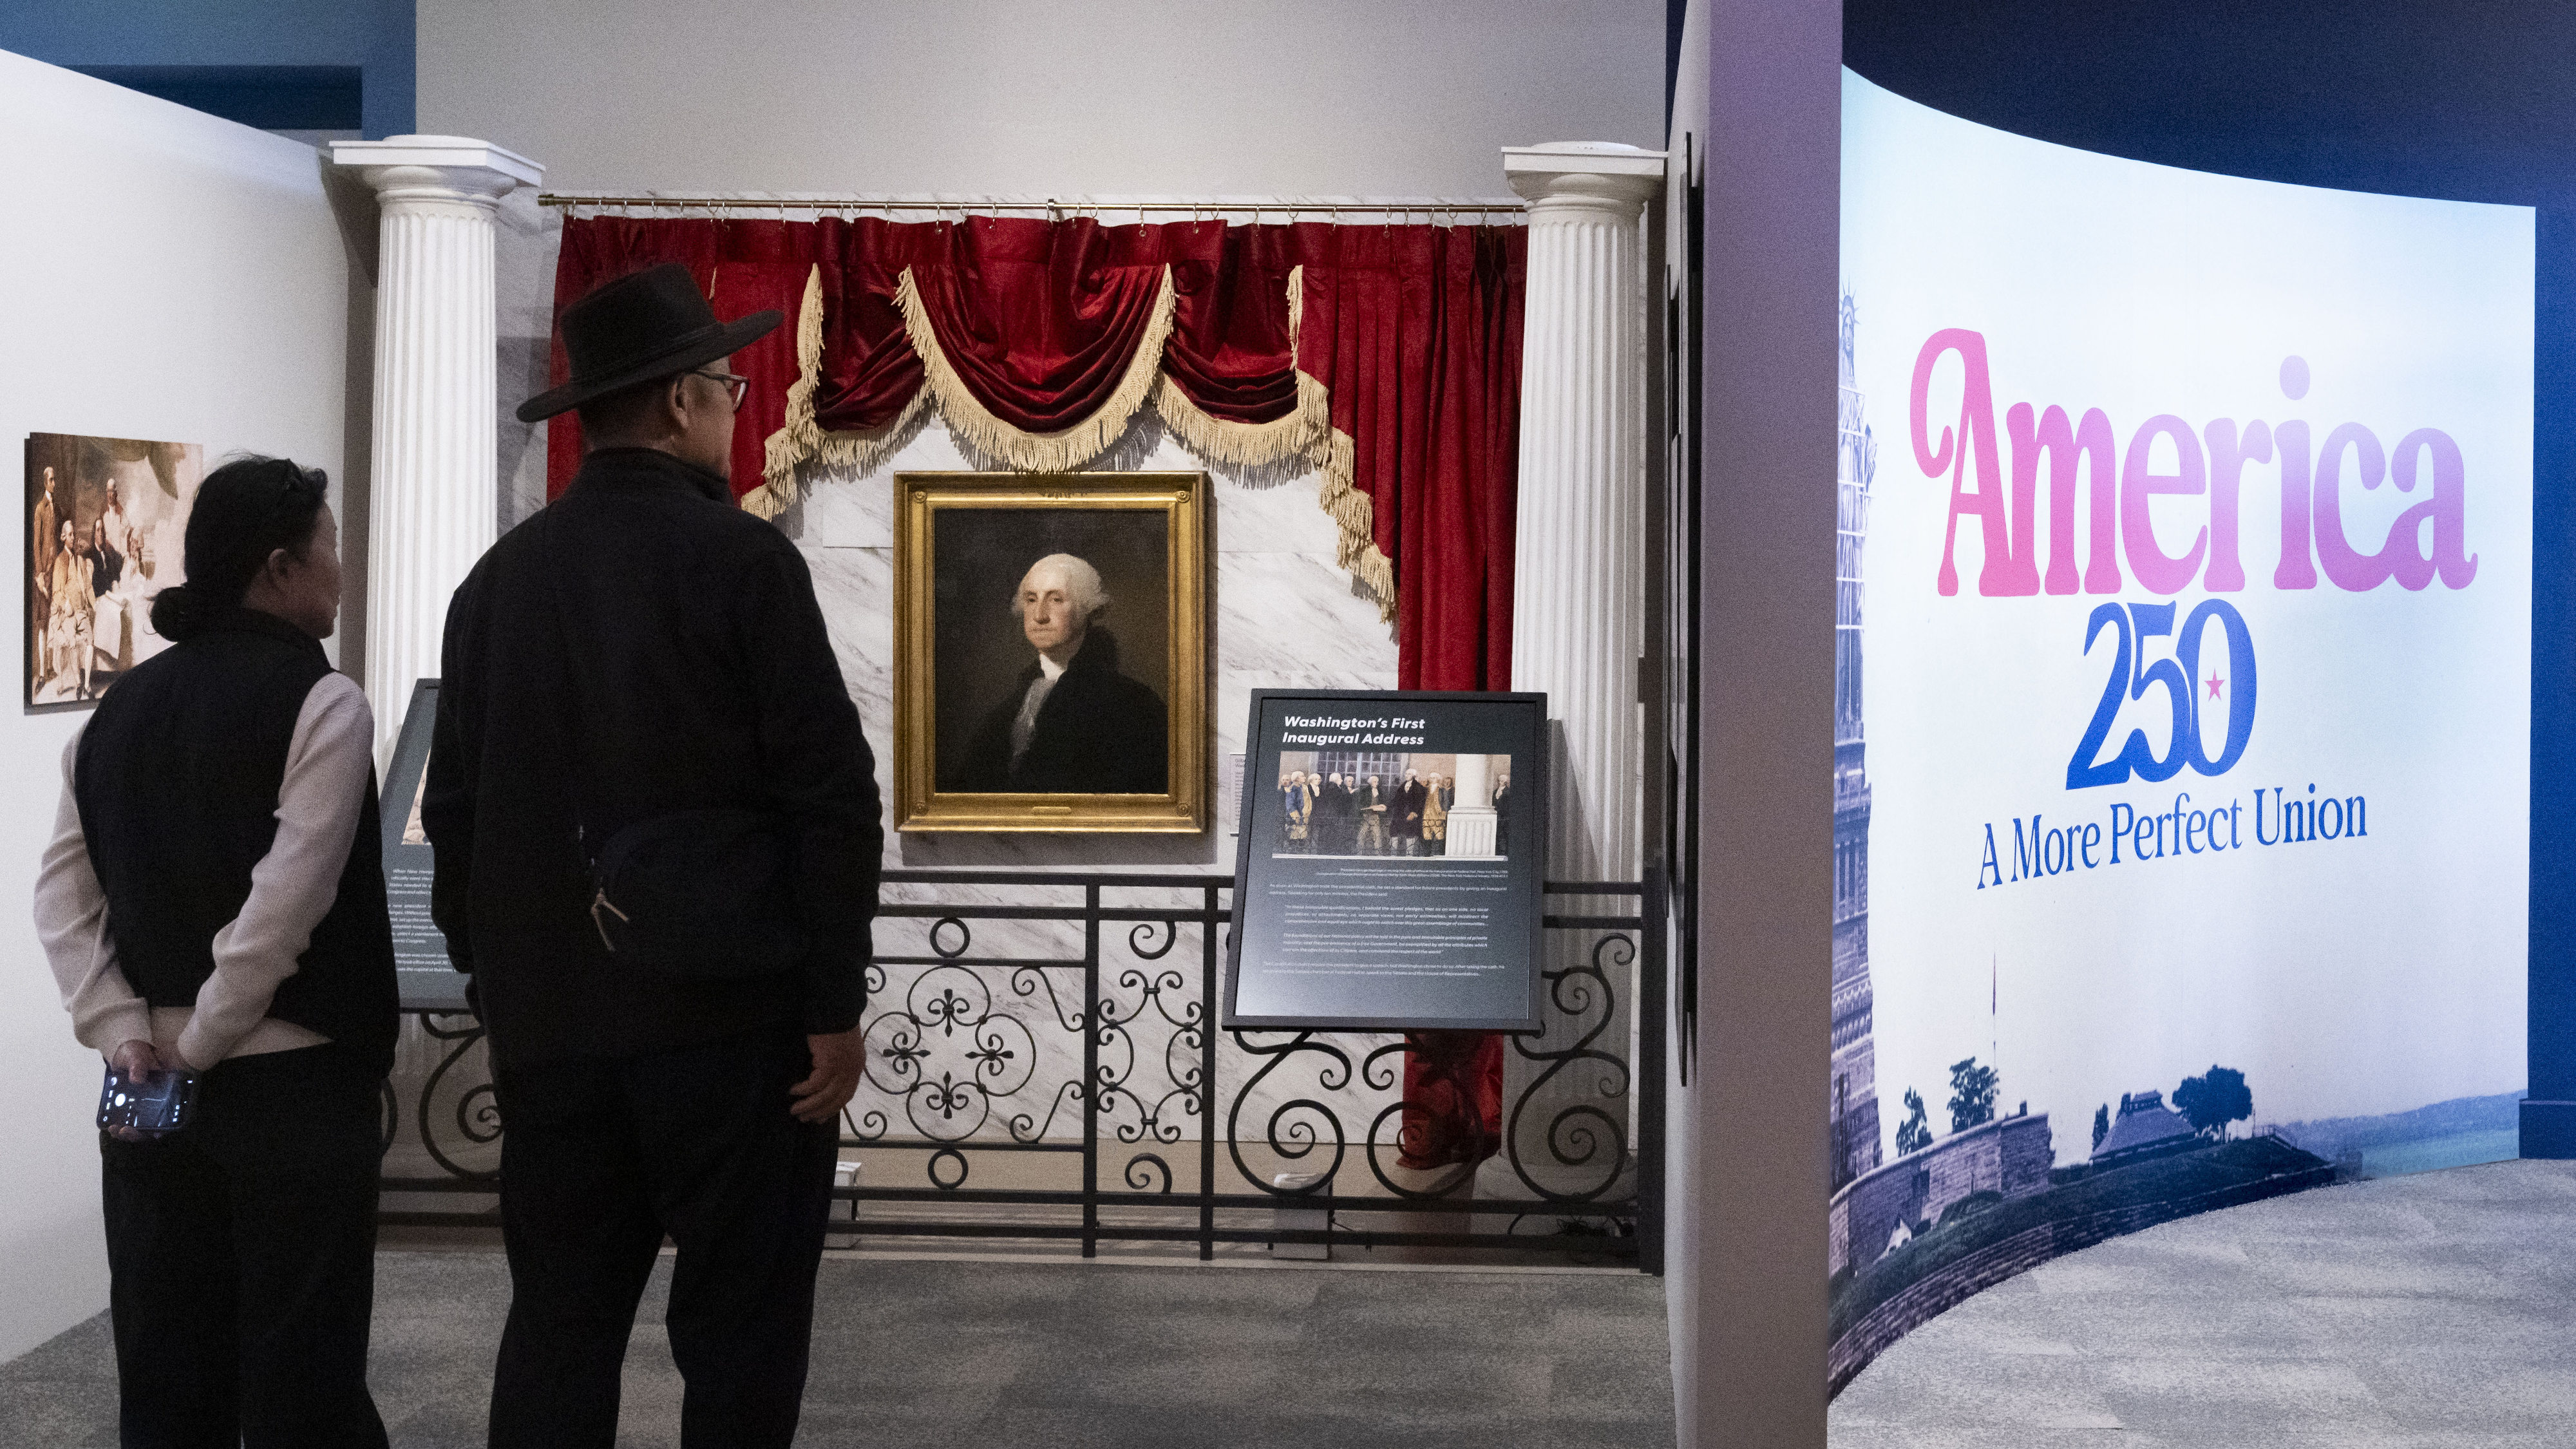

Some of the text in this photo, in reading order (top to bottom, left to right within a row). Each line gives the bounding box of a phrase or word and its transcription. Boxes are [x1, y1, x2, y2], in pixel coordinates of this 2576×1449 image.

[1909, 328, 2479, 597] America
[1282, 732, 1425, 746] Inaugural Address
[1284, 715, 1426, 730] Washington's First
[2065, 598, 2257, 791] 250
[1977, 782, 2368, 891] A More Perfect Union
